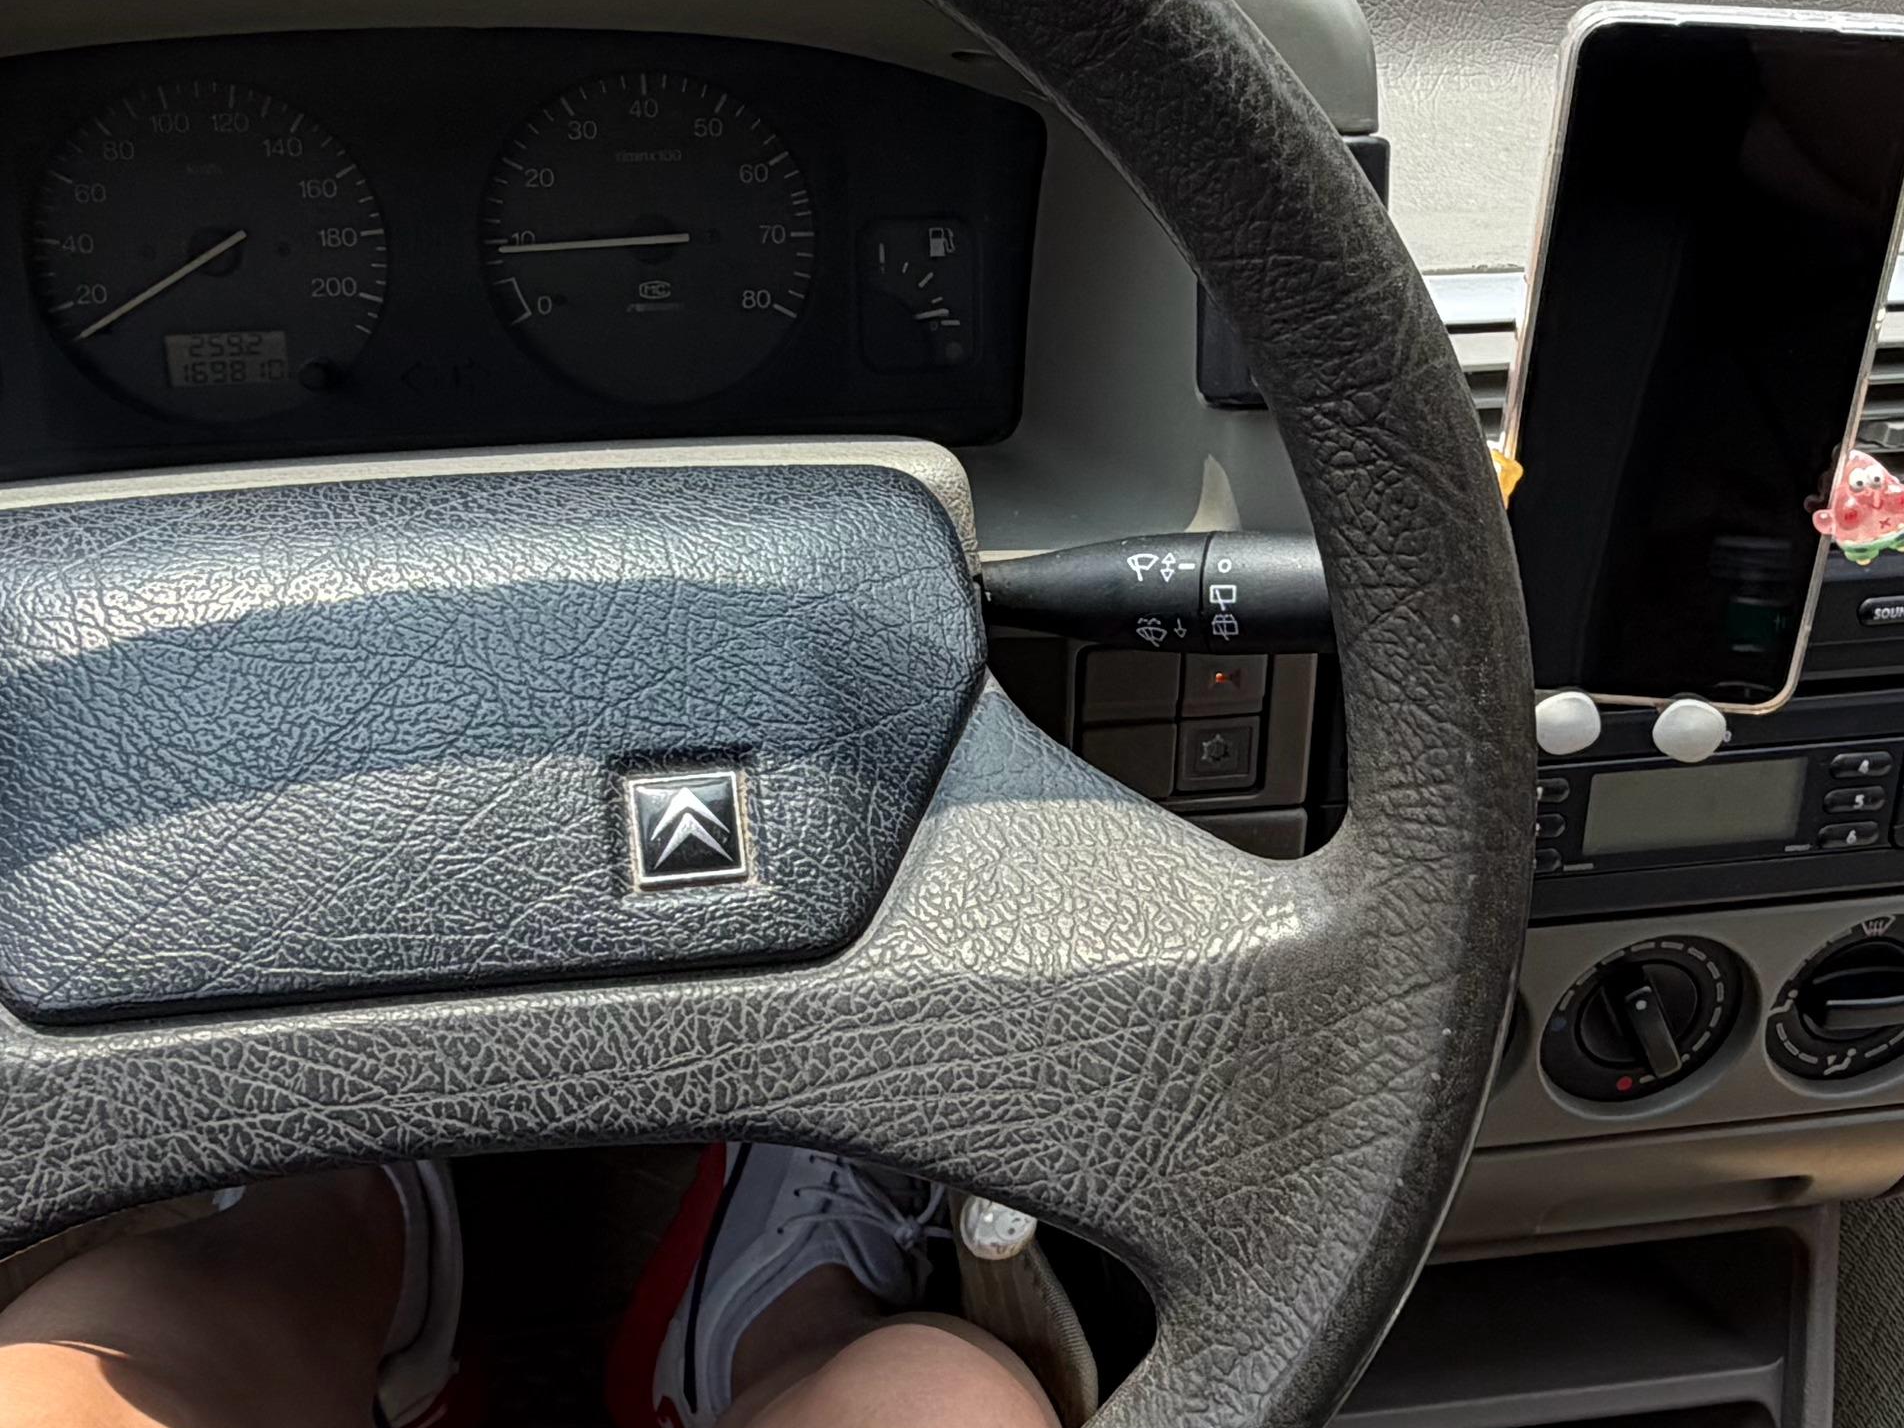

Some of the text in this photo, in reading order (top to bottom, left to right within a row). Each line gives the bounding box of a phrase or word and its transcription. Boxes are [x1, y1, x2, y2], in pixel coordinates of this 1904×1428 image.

[629, 99, 659, 119] 40
[150, 113, 189, 133] 100
[212, 113, 250, 133] 120
[567, 120, 597, 141] 30
[693, 118, 723, 138] 50
[103, 140, 135, 162] 80
[263, 137, 303, 158] 140
[524, 168, 554, 188] 20
[739, 164, 769, 184] 60
[75, 184, 106, 204] 60
[299, 179, 338, 200] 160
[63, 233, 94, 254] 40
[319, 227, 358, 248] 180
[759, 224, 787, 244] 70
[76, 284, 108, 305] 20
[311, 277, 358, 298] 200
[536, 296, 552, 315] 0
[742, 290, 772, 309] 80
[1857, 758, 1871, 775] 4
[1852, 794, 1866, 810] 5
[1845, 829, 1858, 845] 6
